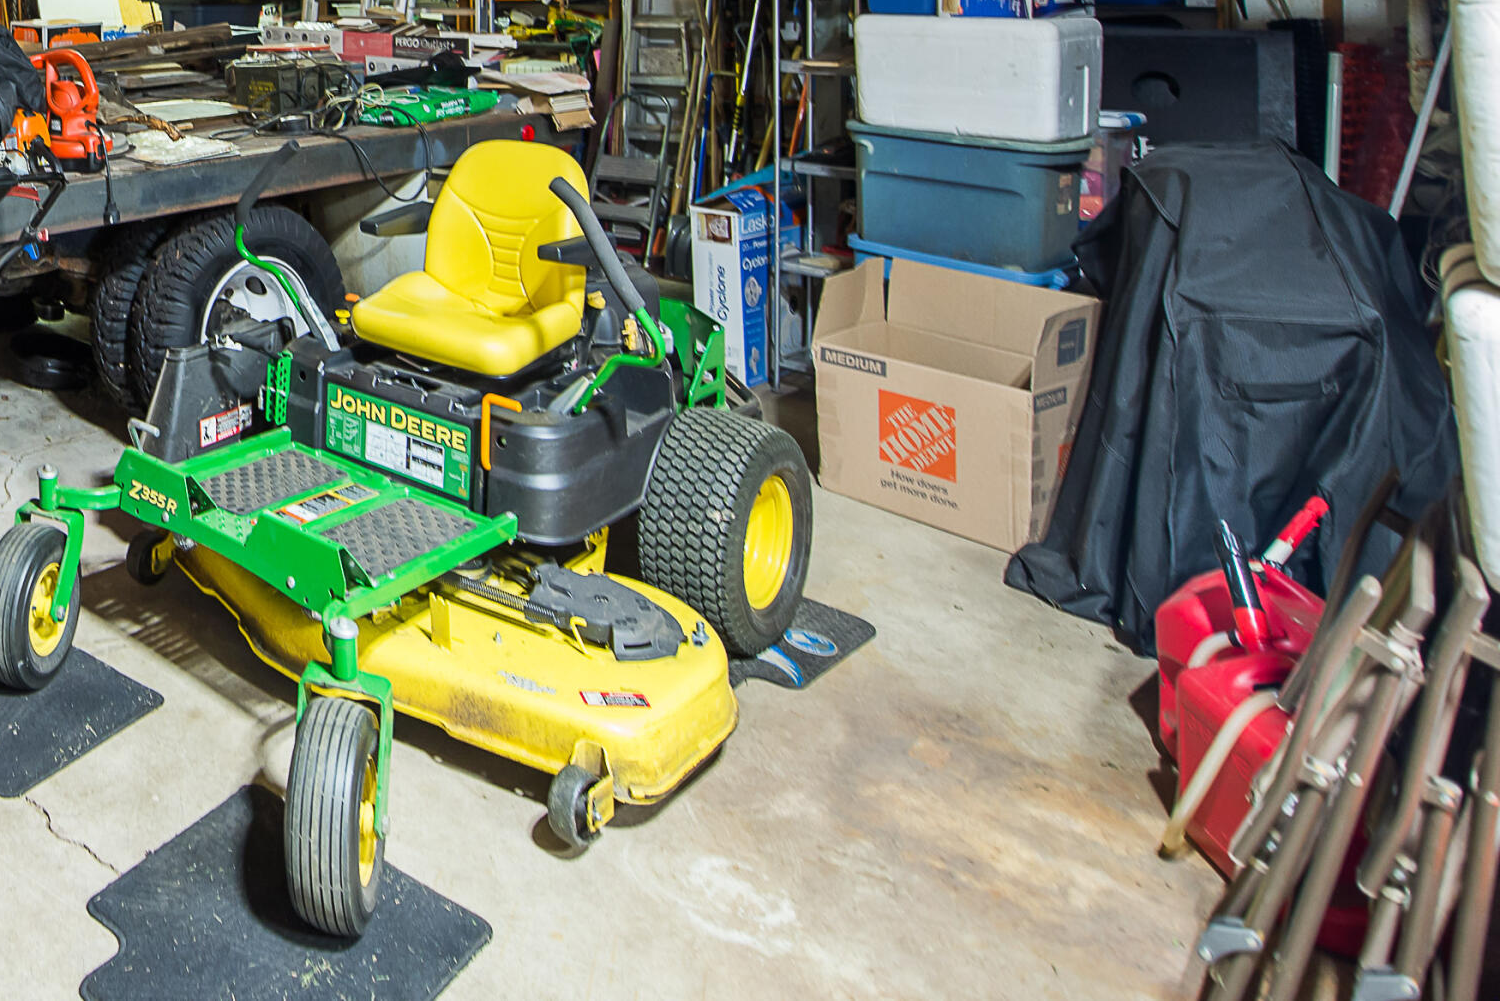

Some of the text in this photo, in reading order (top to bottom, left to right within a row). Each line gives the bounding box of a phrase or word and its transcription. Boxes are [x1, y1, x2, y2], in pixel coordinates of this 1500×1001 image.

[395, 37, 420, 49] PERGO
[742, 254, 771, 272] Cyclon
[716, 264, 730, 322] Cyclone
[824, 351, 883, 375] MEDIUM
[330, 387, 387, 425] JOHN
[389, 405, 467, 453] DEERE
[886, 402, 918, 430] THE
[880, 404, 956, 465] HOME
[909, 434, 956, 473] DEPOT
[879, 479, 897, 492] get
[898, 485, 927, 500] more
[890, 469, 949, 497] How doers
